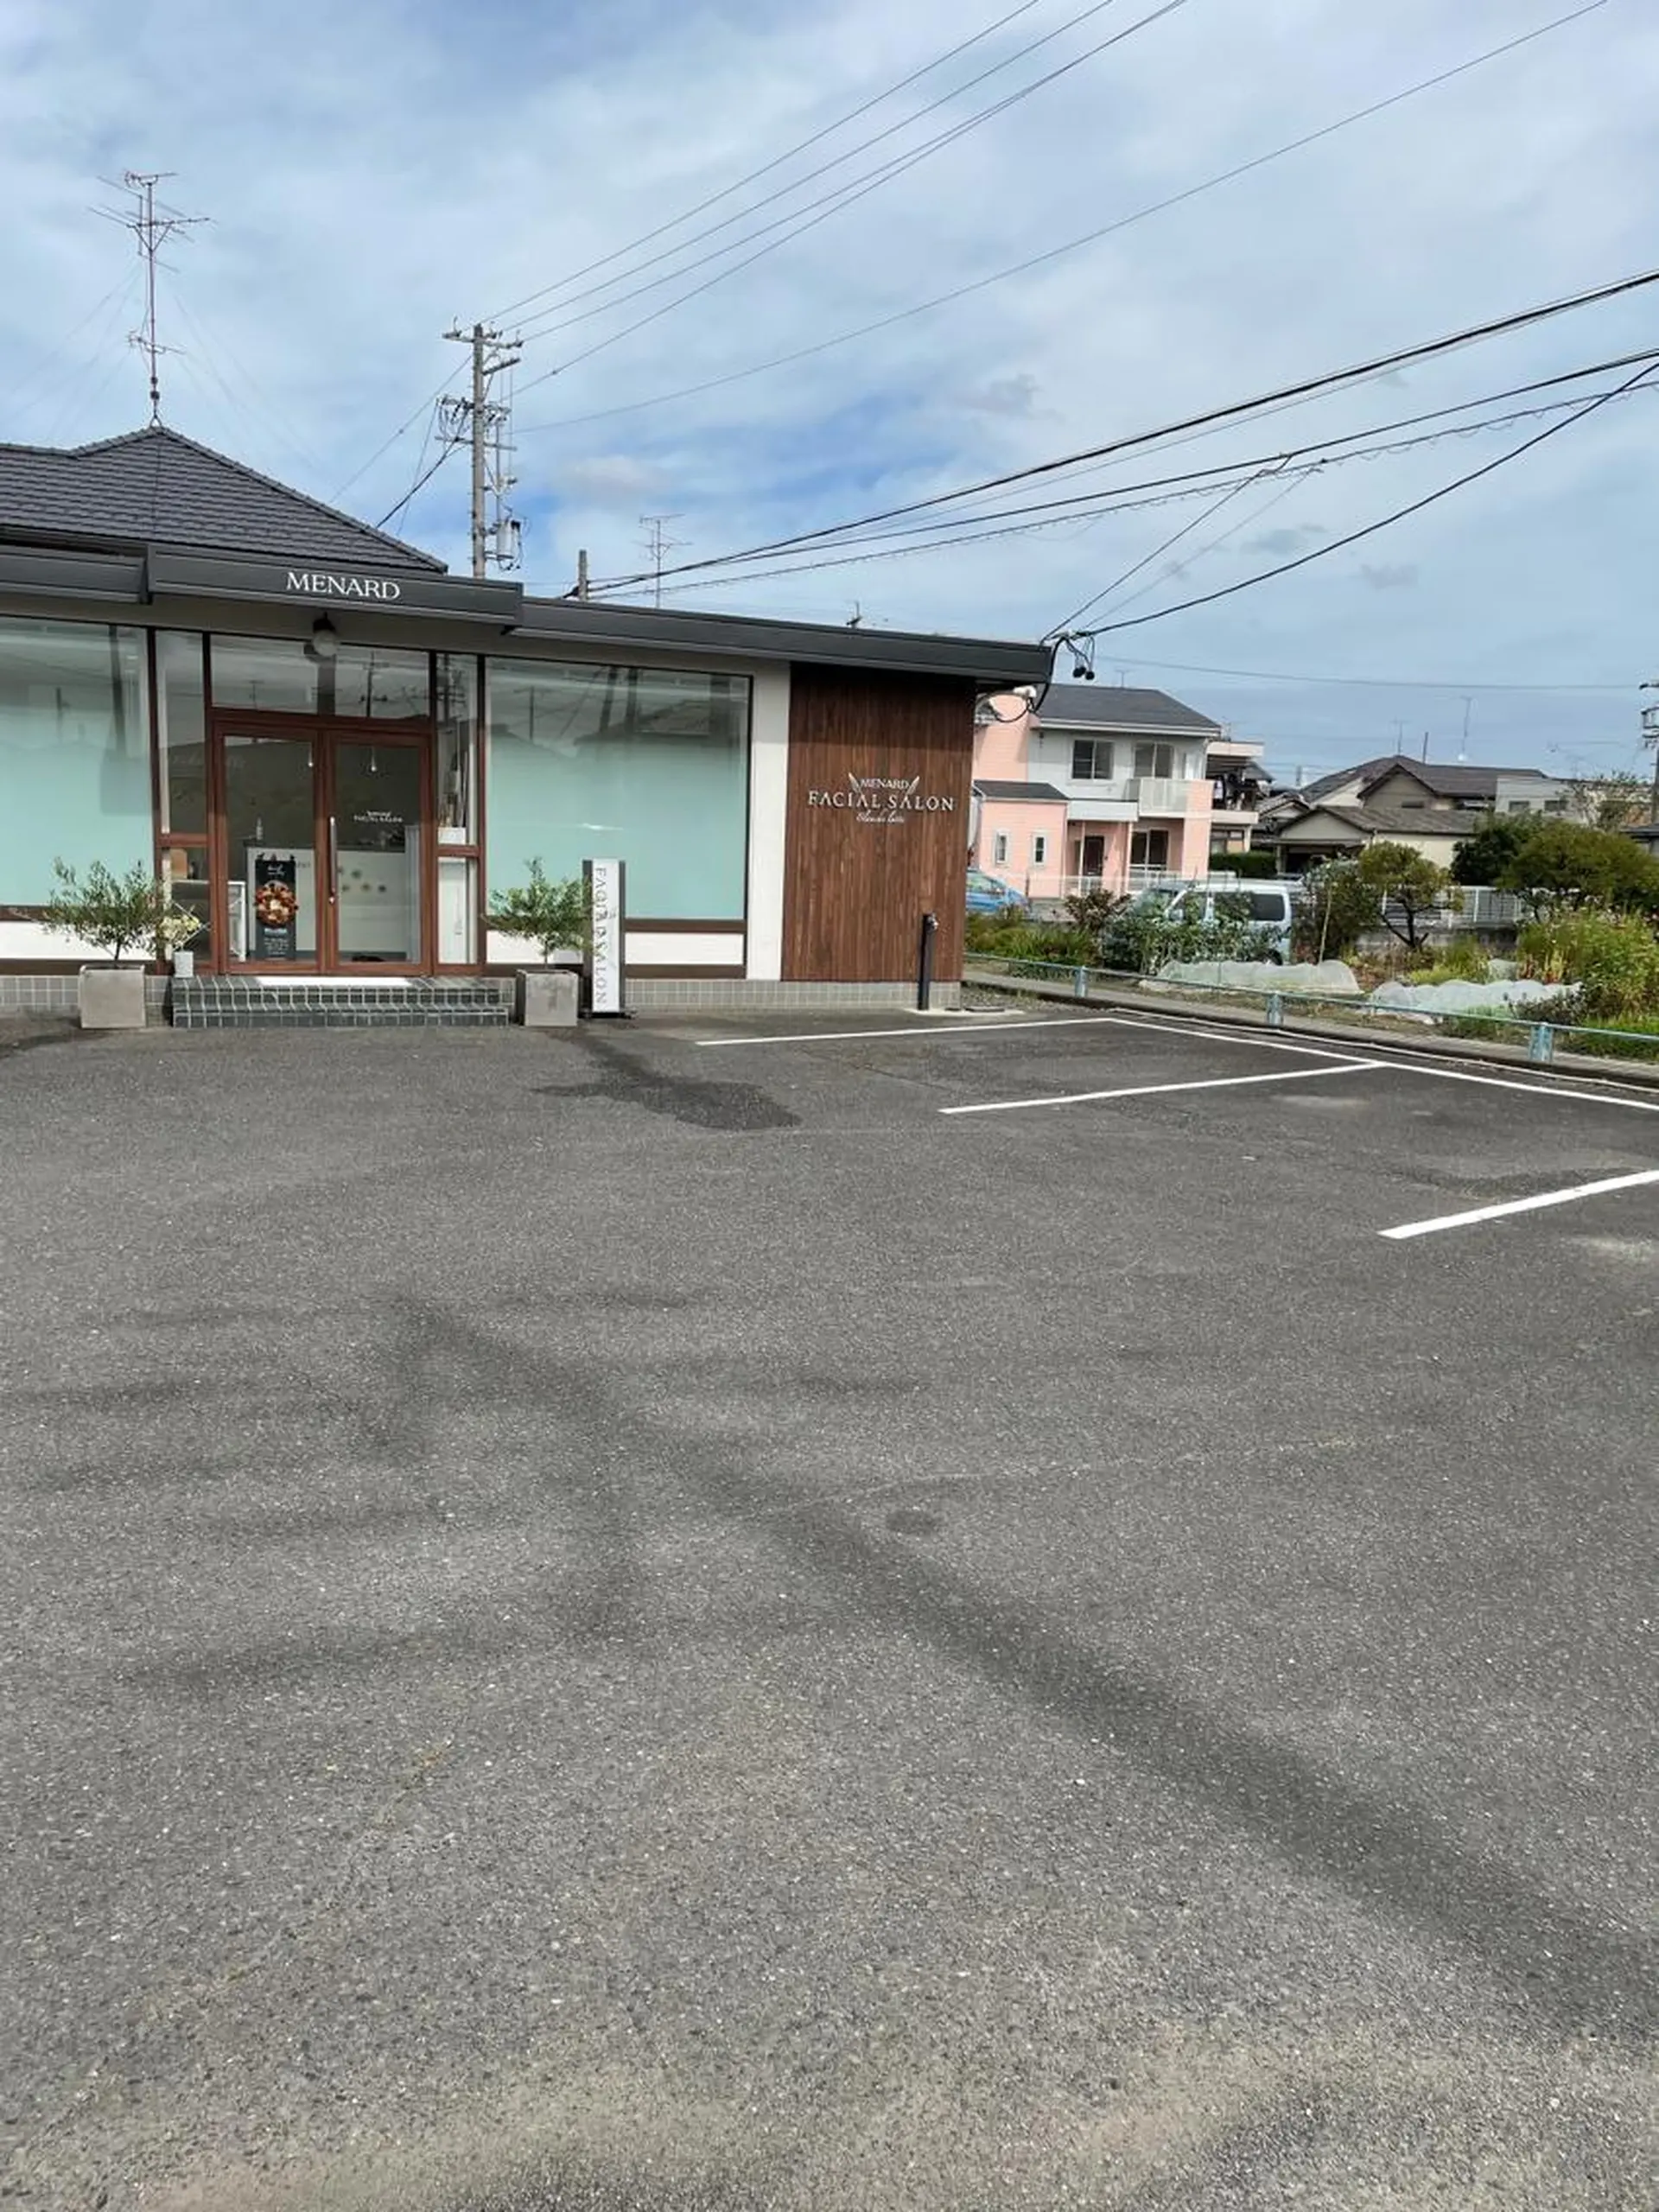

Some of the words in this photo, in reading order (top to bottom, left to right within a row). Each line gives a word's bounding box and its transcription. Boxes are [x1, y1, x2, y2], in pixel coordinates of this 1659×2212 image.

[286, 571, 400, 600] MENARD
[860, 778, 909, 791] MENARD
[808, 790, 881, 810] FACIAL
[887, 793, 954, 811] SALON
